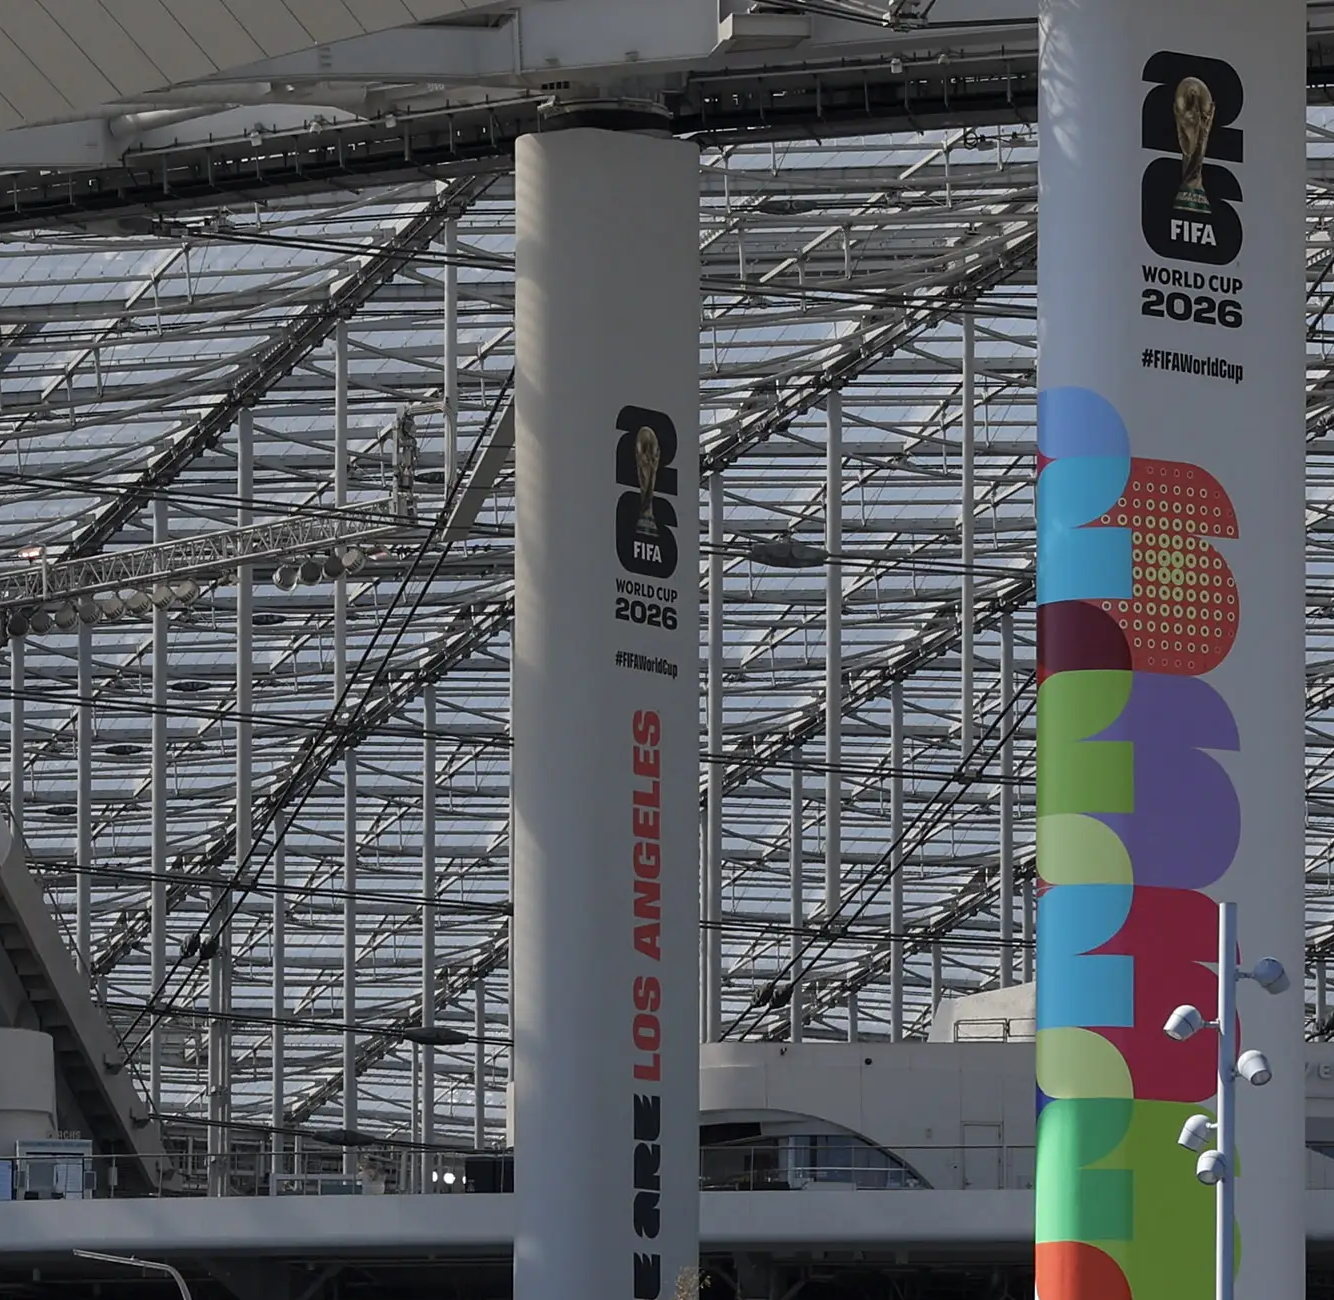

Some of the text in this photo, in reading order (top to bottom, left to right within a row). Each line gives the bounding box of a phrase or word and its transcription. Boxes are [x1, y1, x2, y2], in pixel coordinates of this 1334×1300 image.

[1170, 219, 1217, 246] FIFA
[1142, 265, 1243, 295] WORLD CUP
[1141, 288, 1243, 329] 2026
[1141, 348, 1244, 385] #FIFAWorldCup
[633, 541, 662, 563] FIFA
[615, 577, 678, 603] WORLD CUP
[615, 597, 678, 631] 2026
[615, 650, 678, 680] #FIFAWorldCup
[632, 709, 661, 961] ANGELES
[633, 976, 661, 1082] LOS
[633, 1093, 661, 1240] ARE
